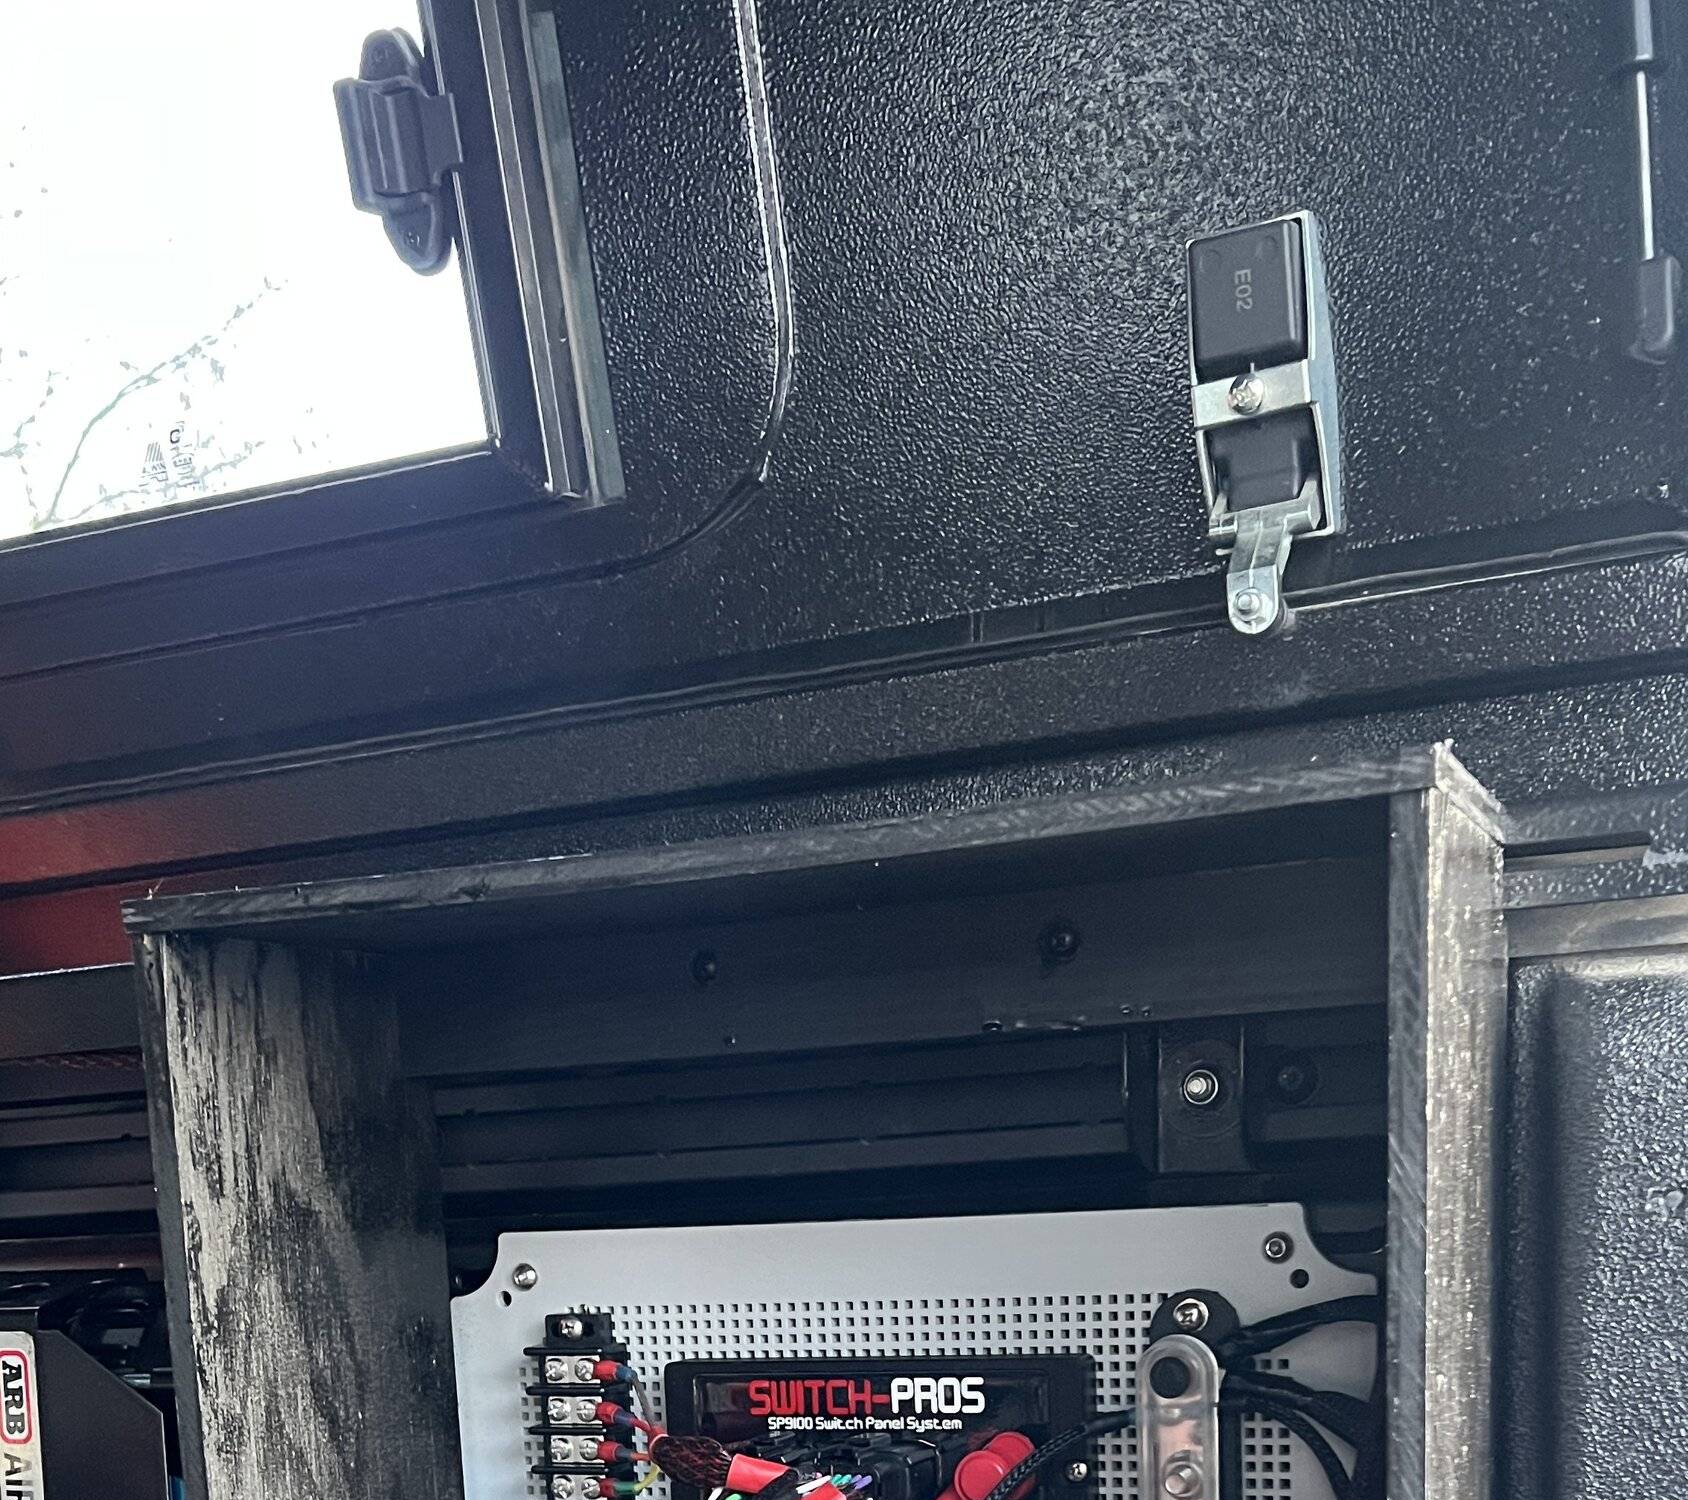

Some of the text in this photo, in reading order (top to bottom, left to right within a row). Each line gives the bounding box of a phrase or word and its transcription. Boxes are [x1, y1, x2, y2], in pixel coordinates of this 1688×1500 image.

[1234, 268, 1253, 312] E02
[1, 1359, 26, 1436] ARB
[748, 1376, 986, 1416] SWITCH-PROS
[767, 1416, 963, 1433] SP9100 Switch Panel System
